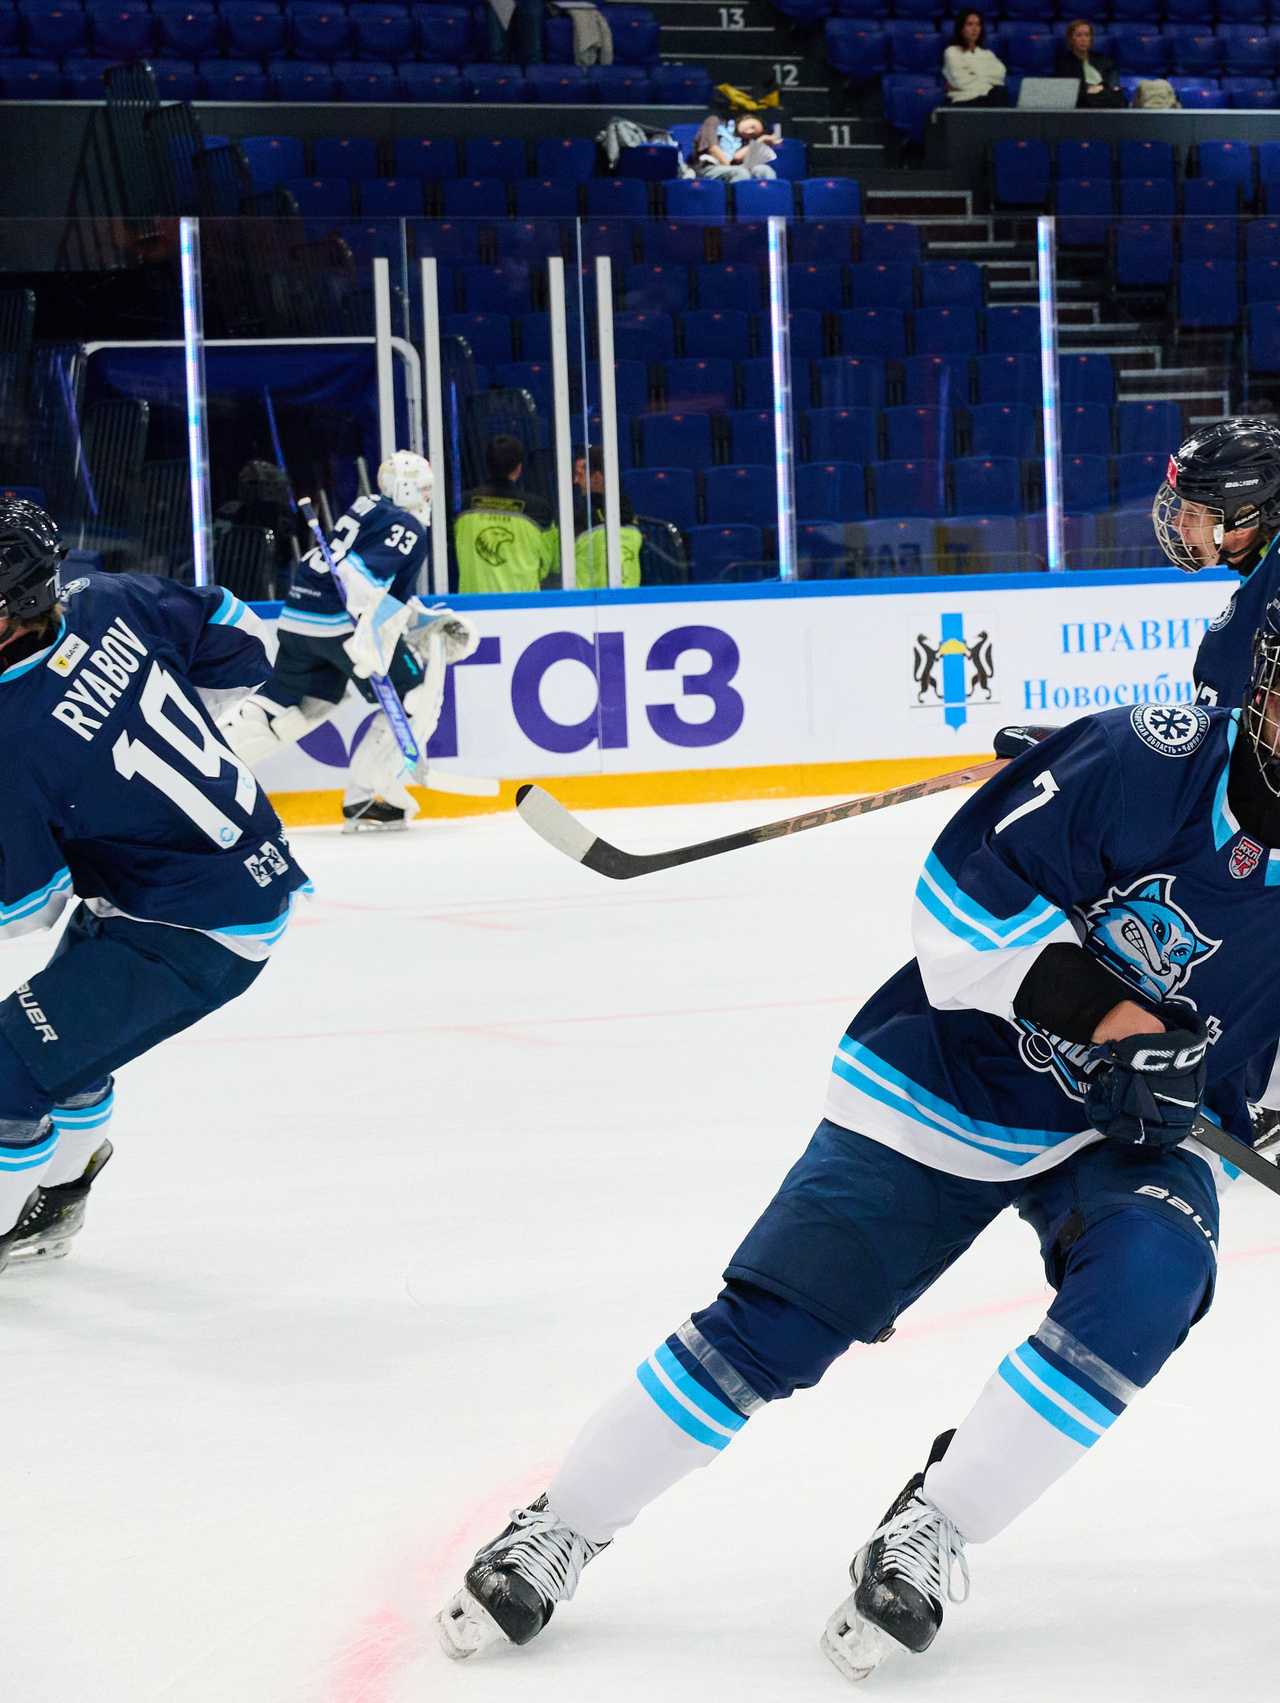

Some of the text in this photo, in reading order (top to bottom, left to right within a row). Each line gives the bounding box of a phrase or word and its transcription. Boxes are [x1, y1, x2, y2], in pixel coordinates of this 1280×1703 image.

[719, 8, 745, 30] 13
[773, 64, 799, 86] 12
[829, 125, 850, 146] 11
[1225, 478, 1259, 489] BAUER
[384, 523, 418, 555] 33
[51, 616, 148, 742] RYABOV
[112, 659, 258, 850] 19
[1146, 735, 1177, 754] ОБЛАСТЬ
[757, 782, 928, 842] SOYUZ
[994, 769, 1060, 835] 7
[1131, 1043, 1207, 1071] CC
